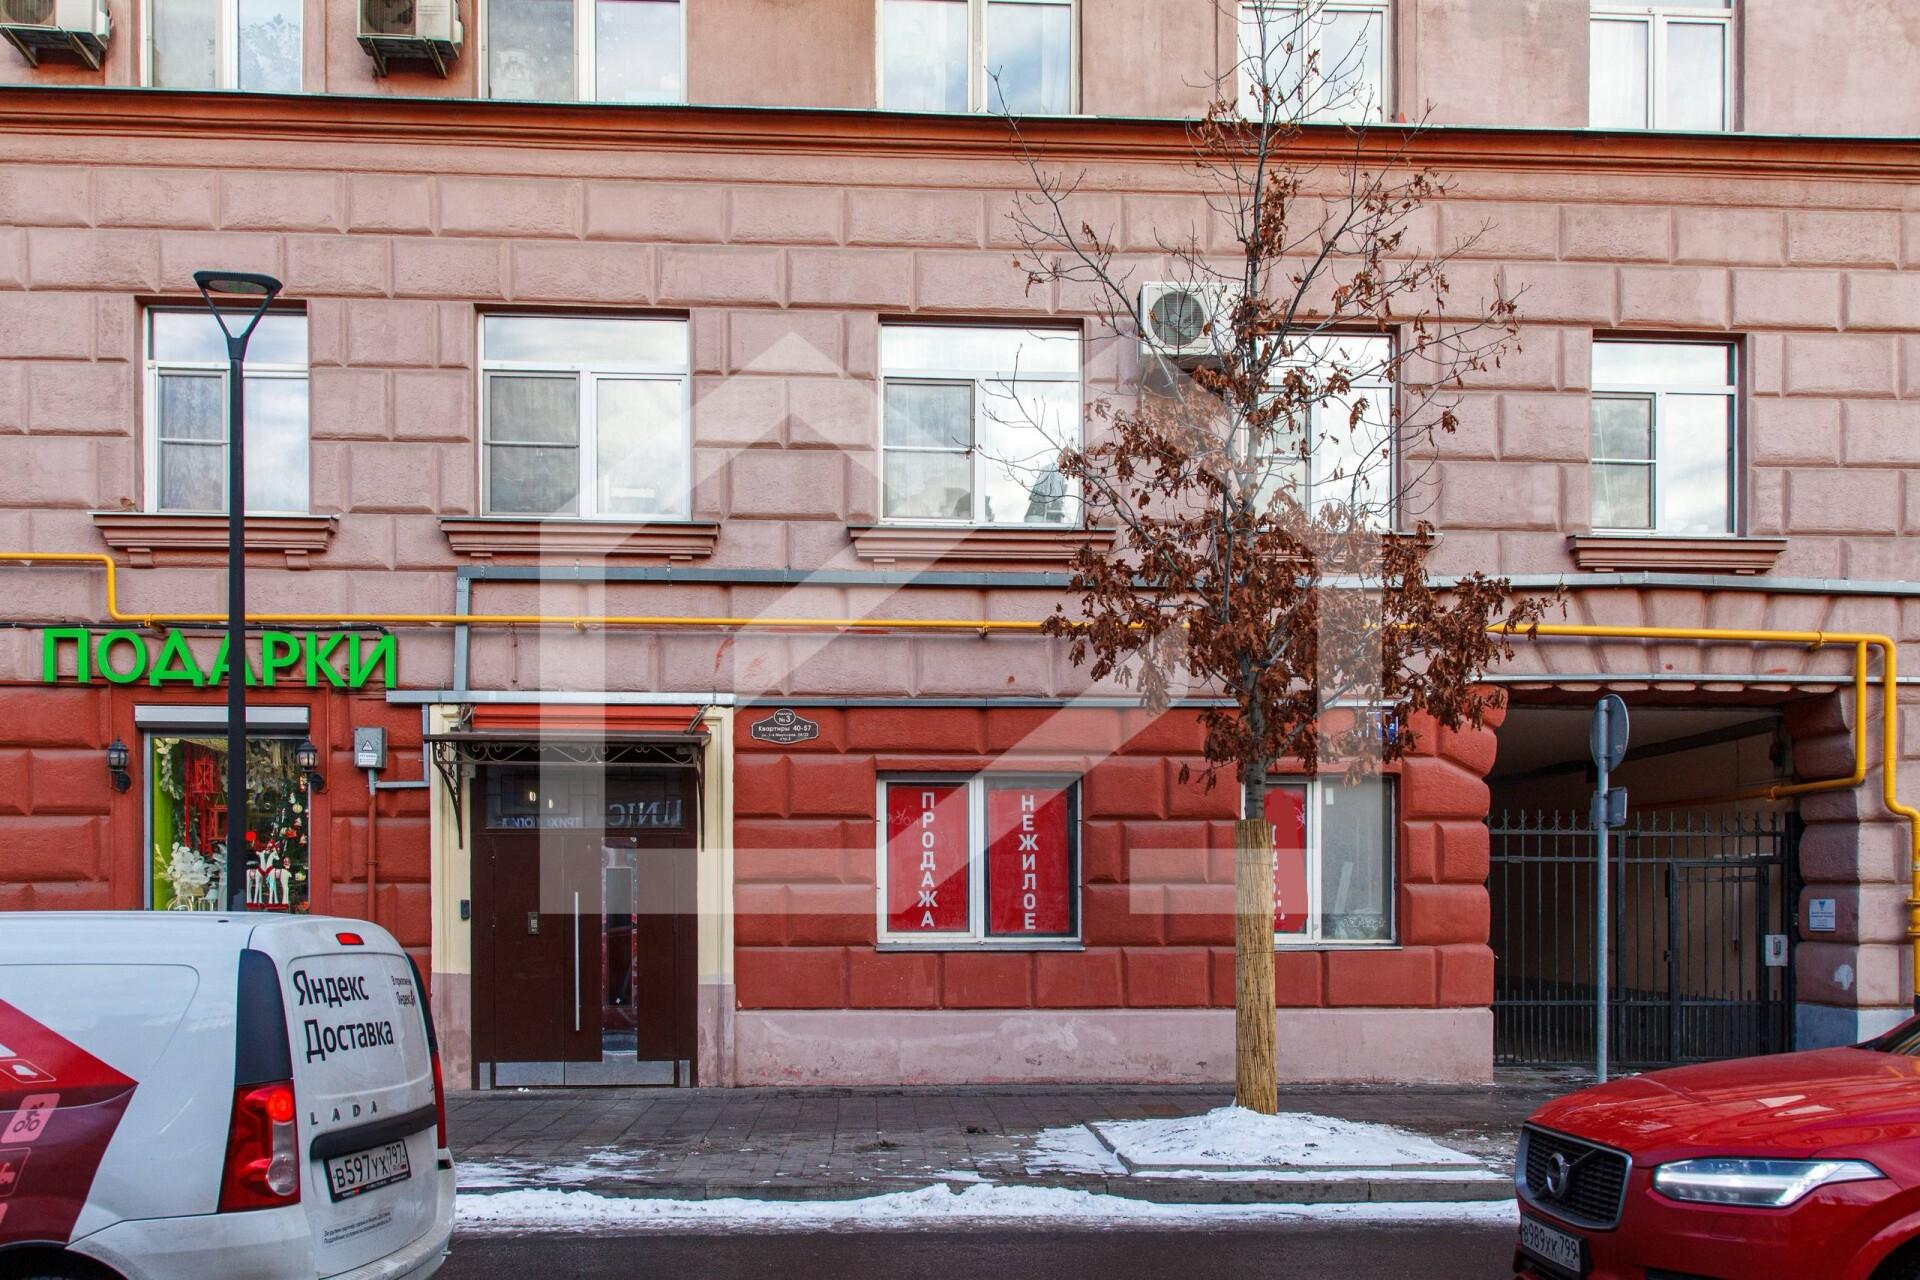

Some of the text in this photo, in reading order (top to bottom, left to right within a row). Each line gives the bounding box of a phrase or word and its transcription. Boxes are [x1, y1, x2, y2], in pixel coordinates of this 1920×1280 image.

[43, 628, 397, 689] ПОДАРКИ
[917, 792, 938, 927] ПРОДАЖА
[1018, 795, 1039, 930] НЕЖИЛОЕ
[293, 970, 369, 1008] Яндекс
[304, 1019, 394, 1064] Доставка
[310, 1101, 378, 1126] LADA
